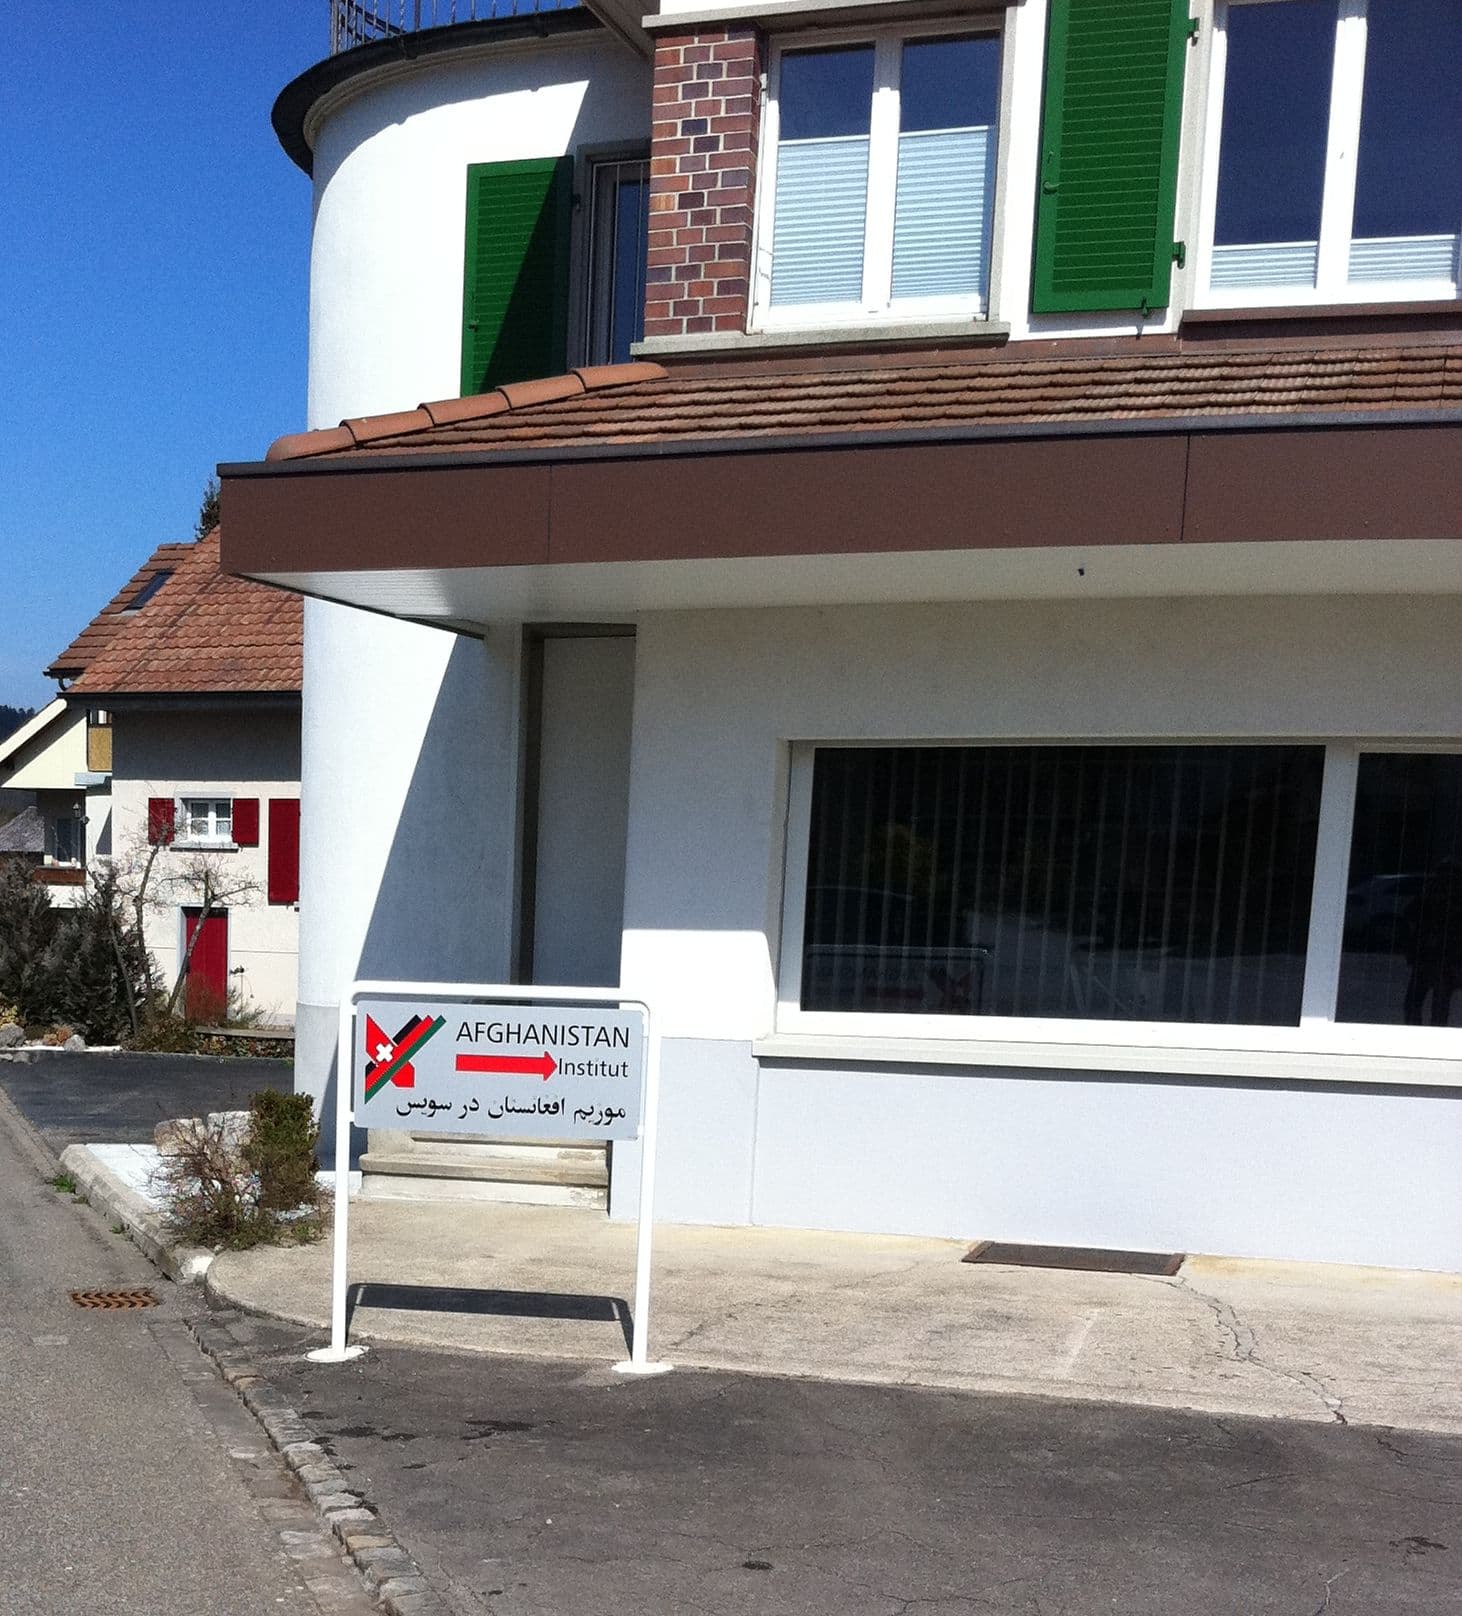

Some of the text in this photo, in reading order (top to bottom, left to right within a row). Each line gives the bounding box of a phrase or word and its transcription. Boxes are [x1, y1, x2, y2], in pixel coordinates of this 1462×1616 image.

[455, 1021, 630, 1048] AFGHANISTAN
[558, 1057, 630, 1078] Institut
[457, 1097, 481, 1120] در
[487, 1095, 566, 1119] افغانستان
